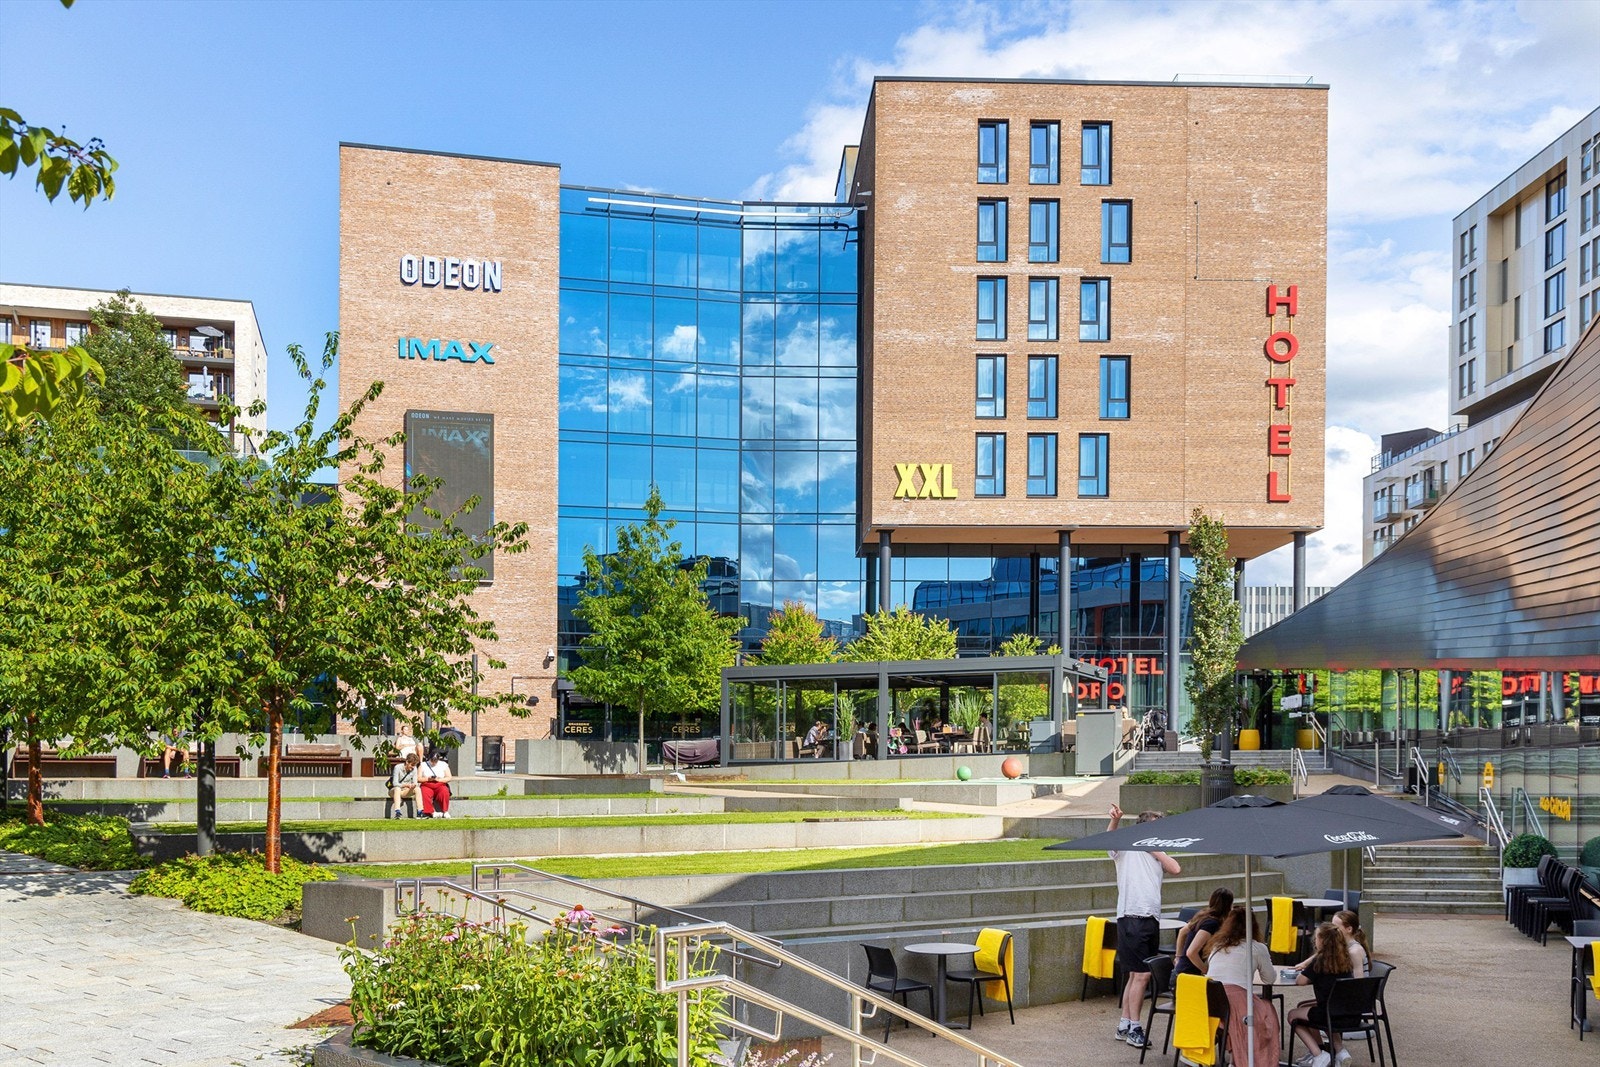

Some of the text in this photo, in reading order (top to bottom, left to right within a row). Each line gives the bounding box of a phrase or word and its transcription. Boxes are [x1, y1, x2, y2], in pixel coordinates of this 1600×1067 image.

[400, 253, 502, 292] ODEON
[397, 336, 495, 364] IMAX
[1265, 285, 1299, 502] HOTEL
[421, 427, 481, 443] IMAX
[893, 463, 959, 499] XXL
[564, 726, 593, 734] CERES
[671, 726, 701, 734] CERES
